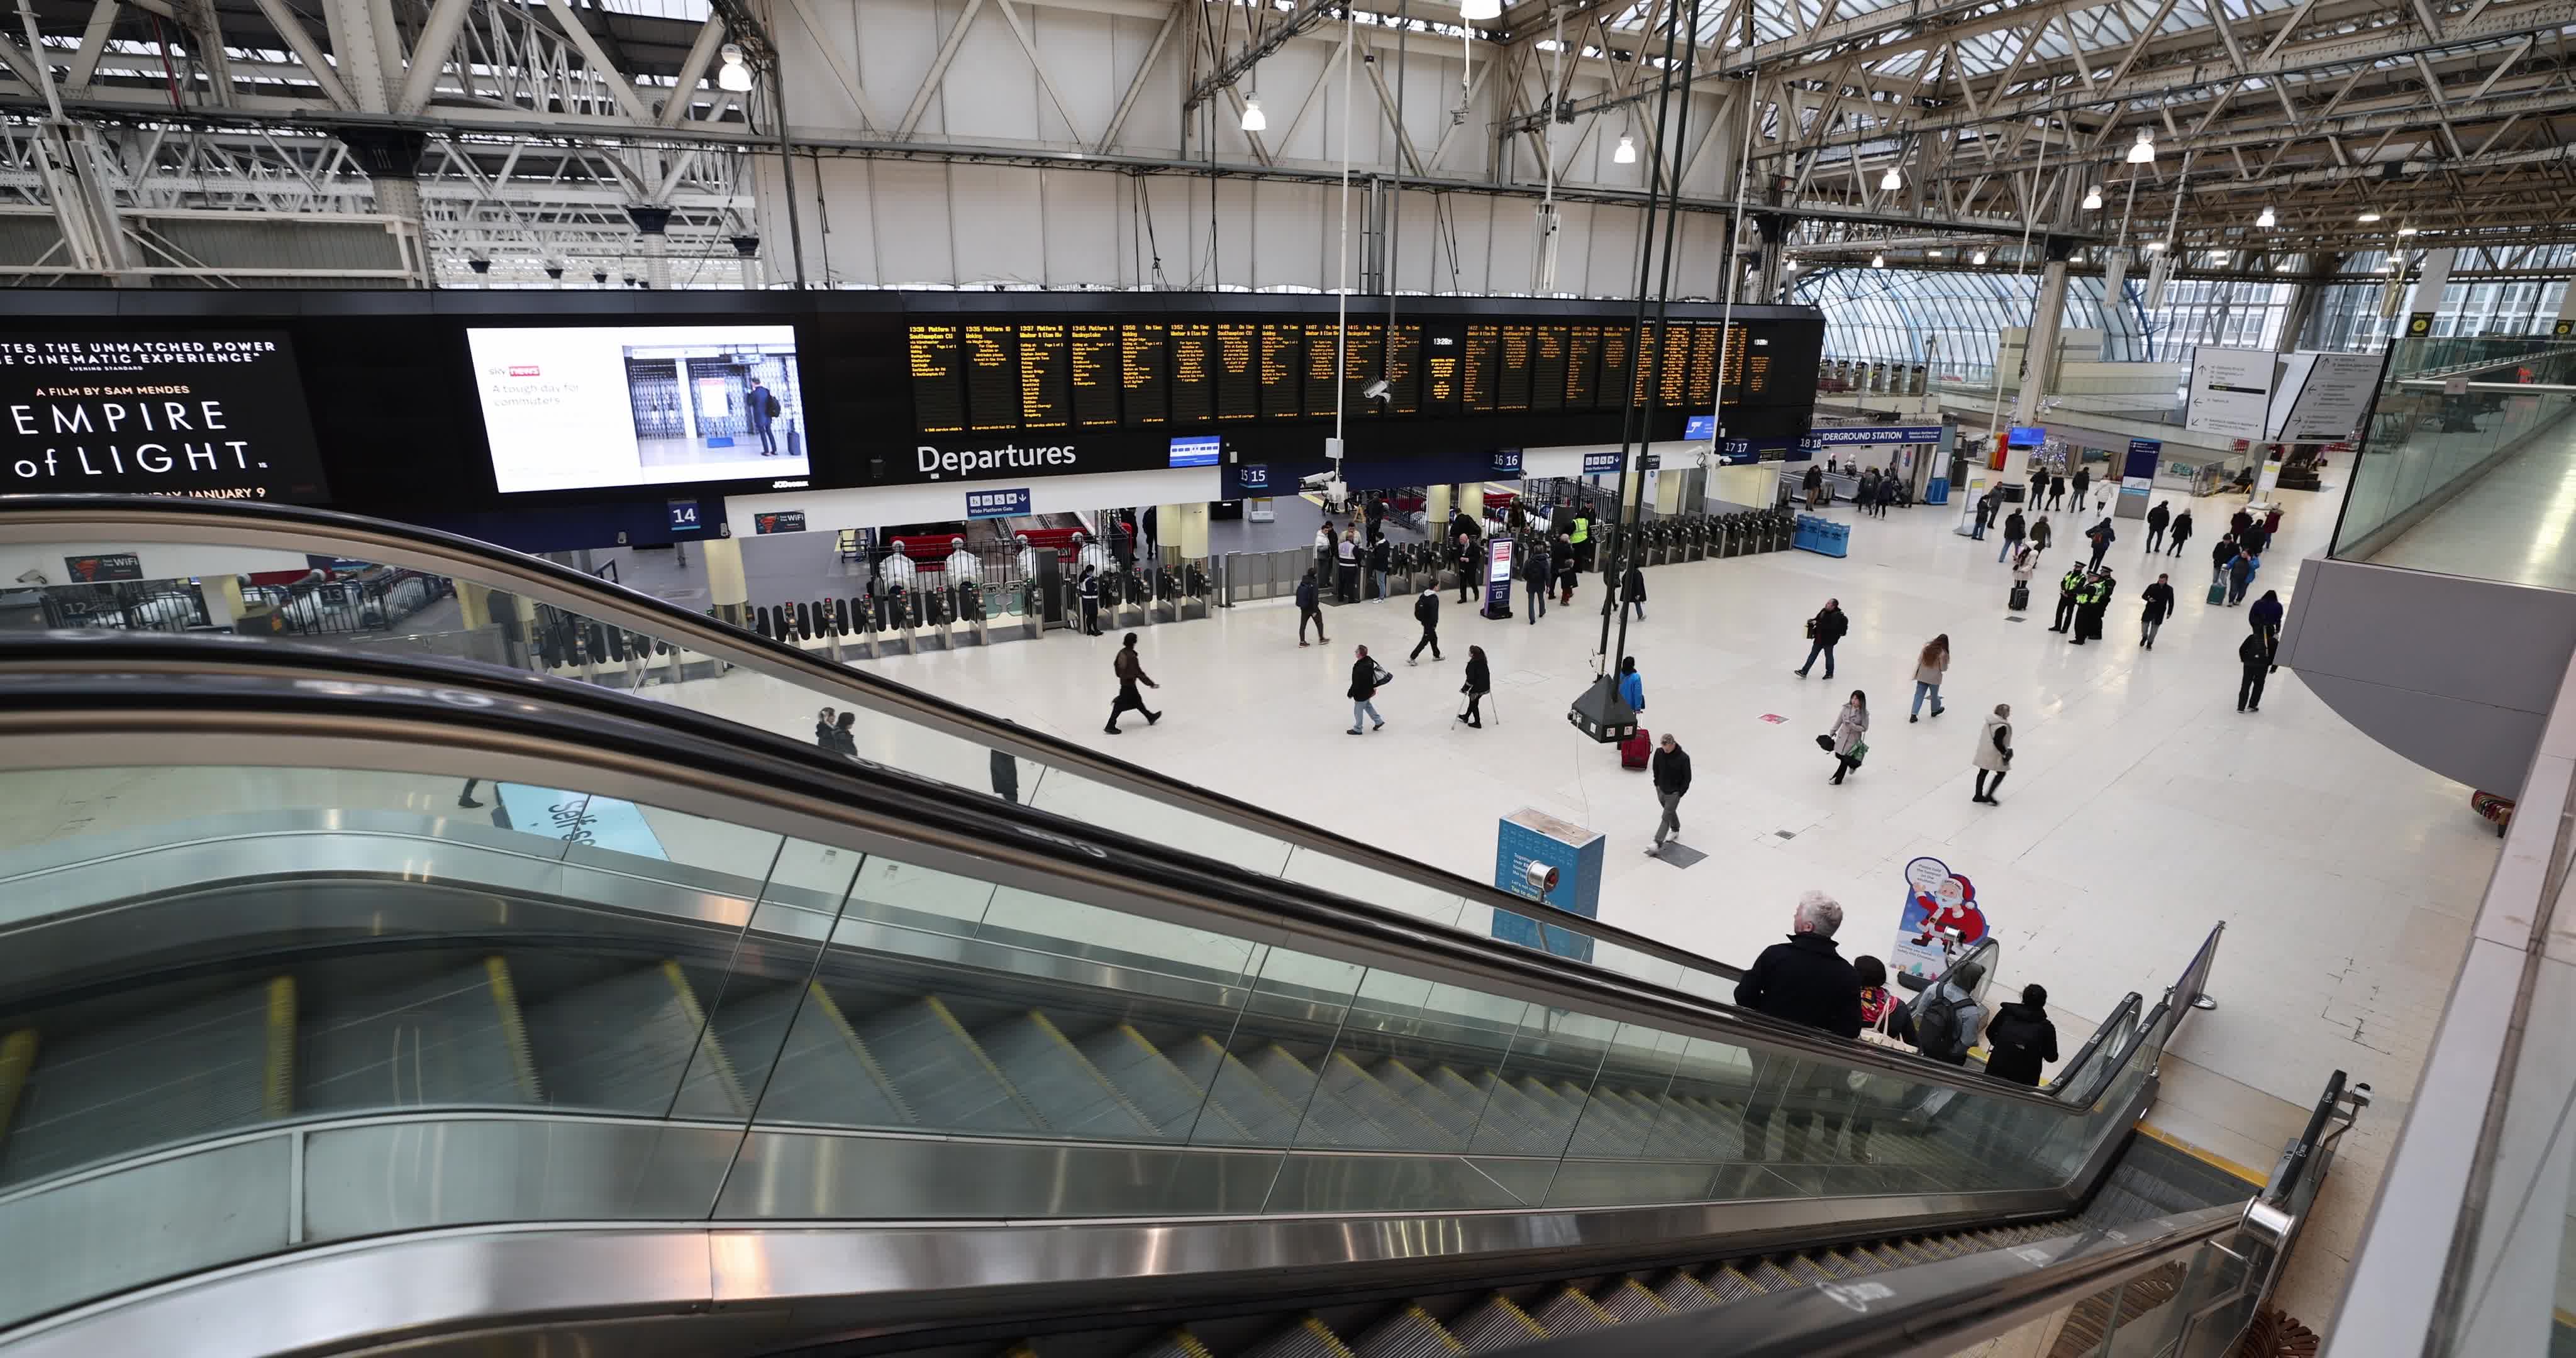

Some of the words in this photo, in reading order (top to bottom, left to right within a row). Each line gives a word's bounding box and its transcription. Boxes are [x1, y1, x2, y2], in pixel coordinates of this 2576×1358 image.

[45, 343, 80, 353] THE
[90, 342, 204, 353] UNMATCHED
[213, 342, 276, 352] POWER
[24, 354, 131, 364] CINEMATIC
[488, 367, 506, 375] sky
[36, 388, 45, 396] A
[136, 385, 190, 394] MENDES
[503, 385, 537, 395] tough
[540, 385, 560, 393] day
[564, 384, 579, 392] for
[494, 397, 560, 407] commuters
[11, 401, 227, 434] EMPIRE
[1823, 432, 1869, 441] DERGROUND
[1872, 431, 1902, 440] STATION
[1725, 442, 1735, 451] 17
[1737, 443, 1748, 453] 17
[1800, 438, 1810, 448] 18
[1813, 438, 1821, 448] 18
[14, 449, 58, 478] of
[917, 444, 1077, 476] Departures
[1494, 453, 1503, 465] 16
[1506, 454, 1518, 466] 16
[1240, 468, 1248, 482] 15
[1251, 469, 1266, 482] 15
[189, 488, 252, 499] JANUARY
[256, 487, 265, 497] 9
[673, 507, 696, 523] 14
[113, 558, 138, 566] WiFi
[323, 588, 342, 600] 13
[65, 602, 86, 614] 12
